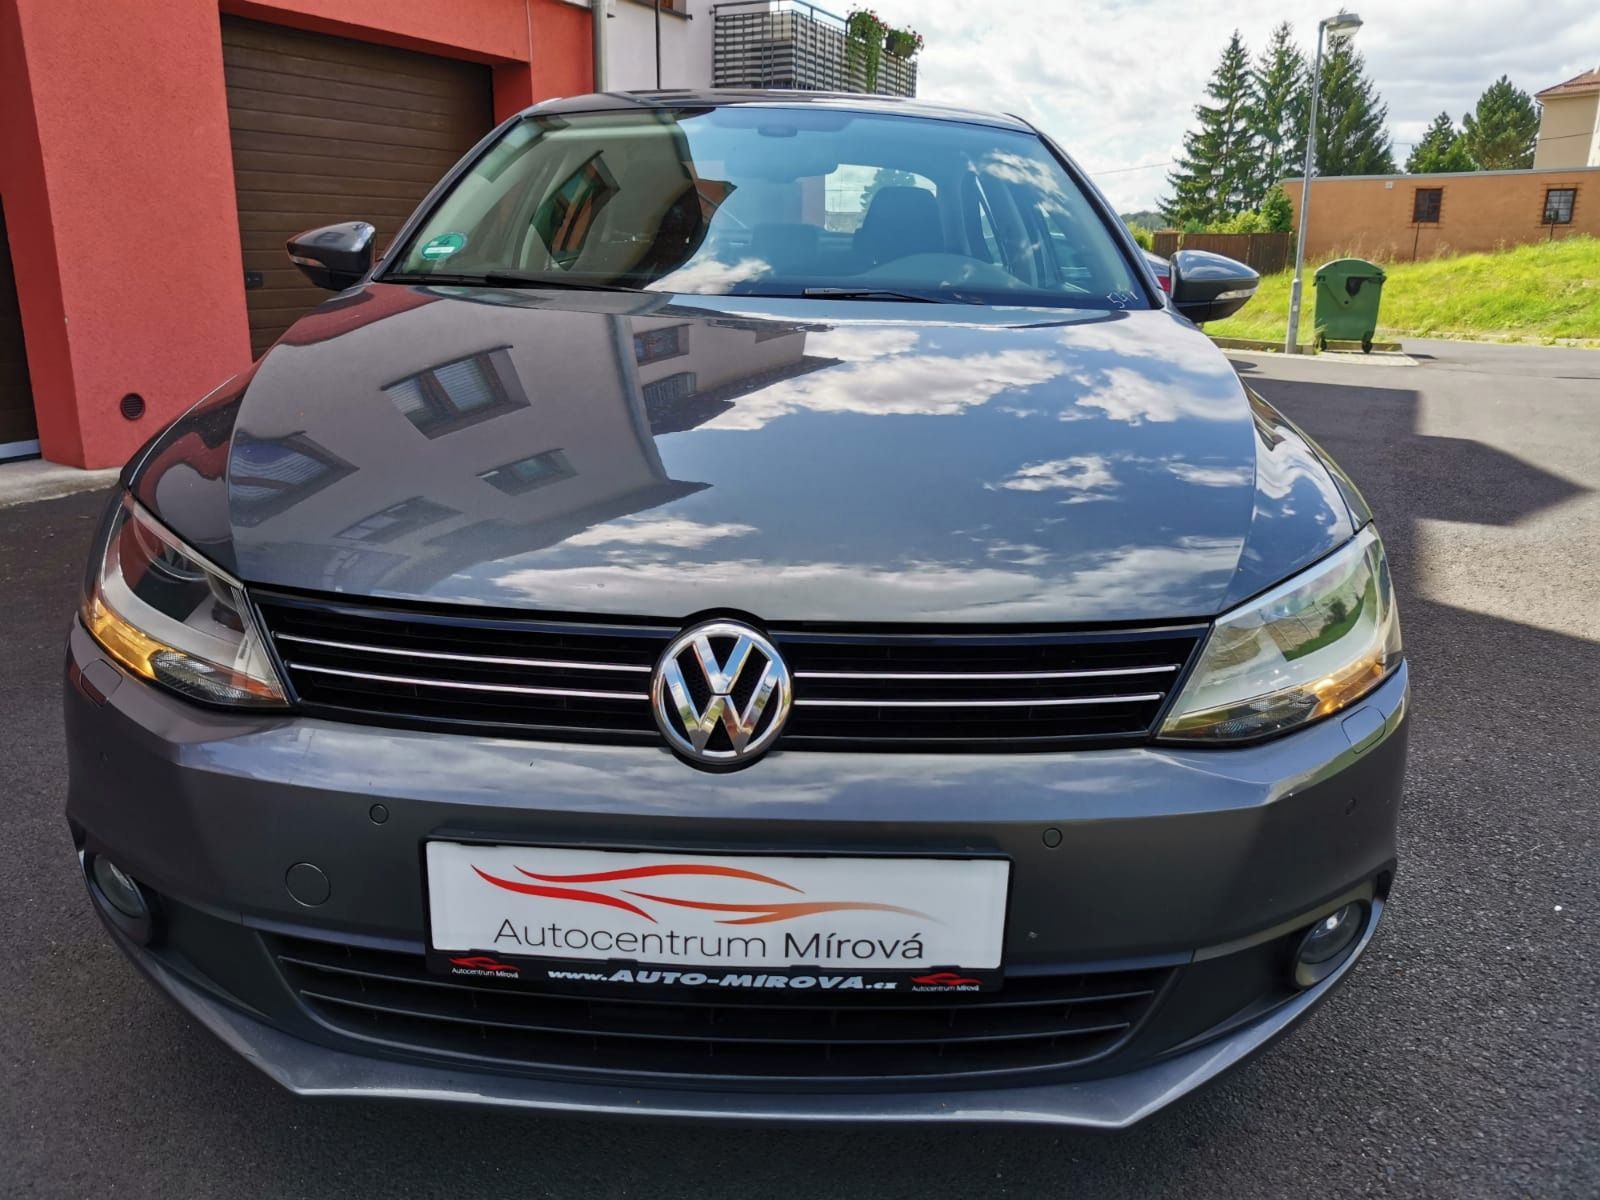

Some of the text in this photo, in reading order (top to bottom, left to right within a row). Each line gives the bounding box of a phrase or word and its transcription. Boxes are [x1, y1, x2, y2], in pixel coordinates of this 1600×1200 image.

[493, 918, 924, 960] Autocentrum Mírová
[451, 967, 495, 977] Autocentrum
[911, 984, 956, 992] Autocentrum
